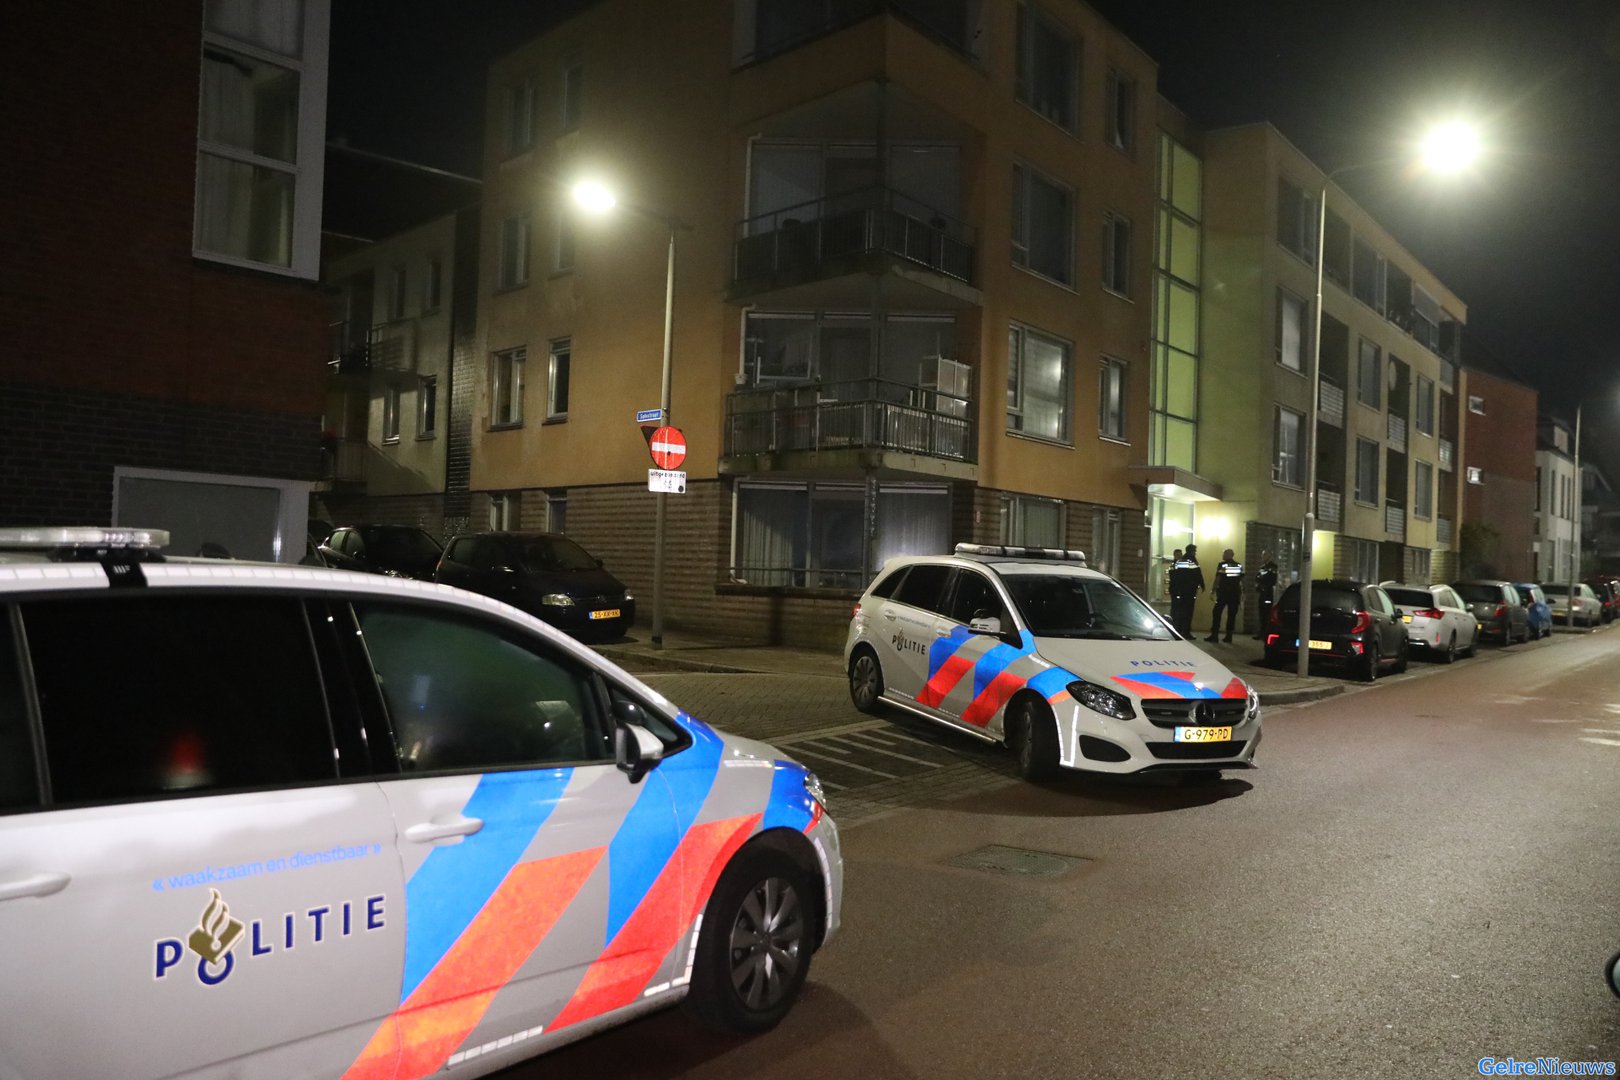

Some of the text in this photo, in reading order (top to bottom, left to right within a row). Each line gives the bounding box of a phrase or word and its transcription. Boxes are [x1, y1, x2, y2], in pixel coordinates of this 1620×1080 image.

[892, 635, 926, 655] POLITIE
[1184, 729, 1228, 740] G-979-PD
[168, 861, 263, 889] waakzaam
[266, 856, 287, 873] en
[289, 844, 369, 869] dienstbaar
[155, 895, 385, 986] POLITIE
